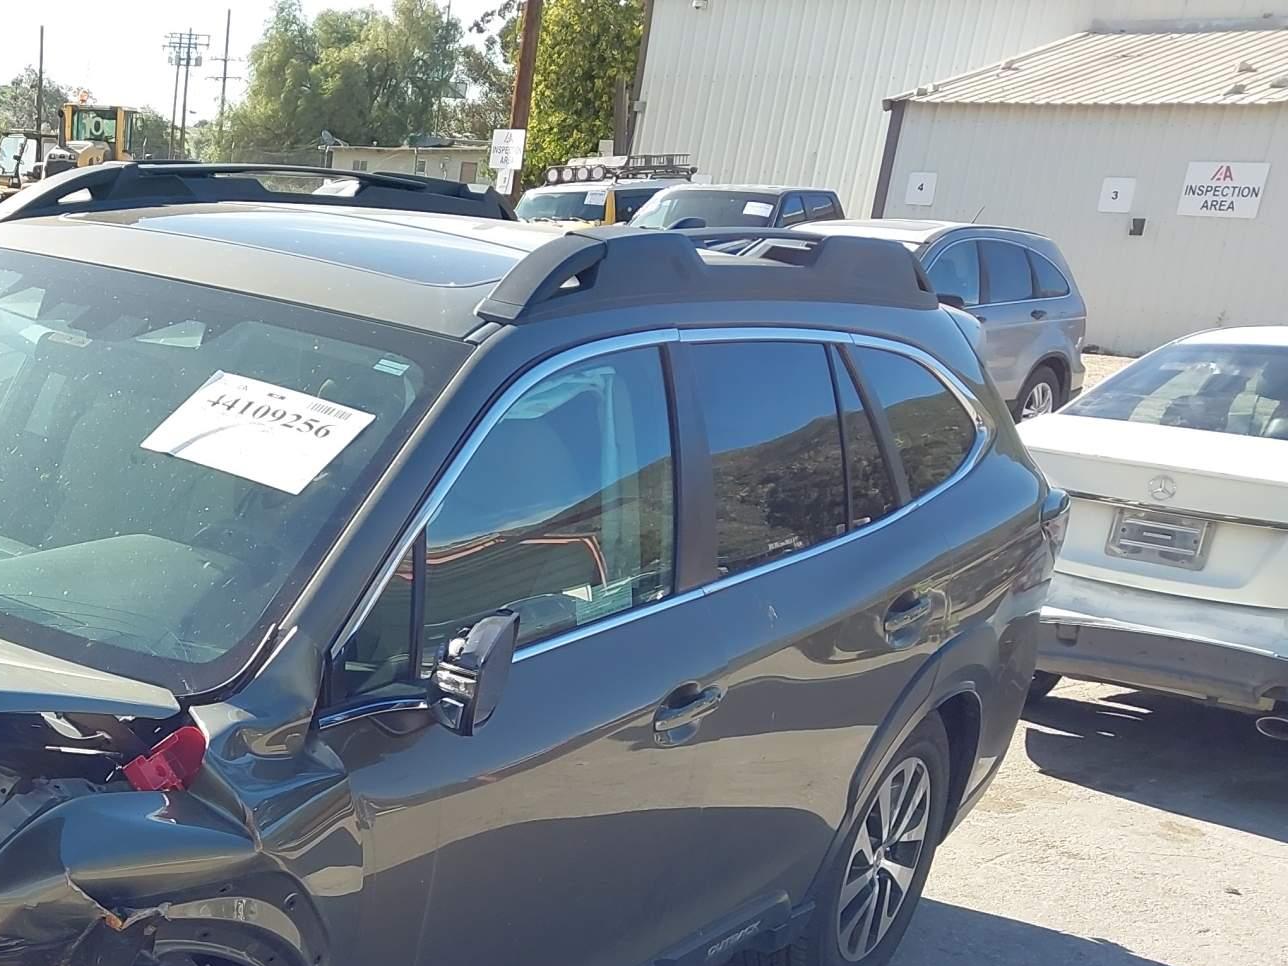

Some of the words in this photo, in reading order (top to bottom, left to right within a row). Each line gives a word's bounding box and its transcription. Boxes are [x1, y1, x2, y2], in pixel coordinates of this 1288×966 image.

[917, 183, 924, 191] 4
[1184, 184, 1261, 198] INSPECTION
[1111, 190, 1119, 201] 3
[1200, 200, 1235, 212] AREA
[207, 393, 336, 439] 44109256
